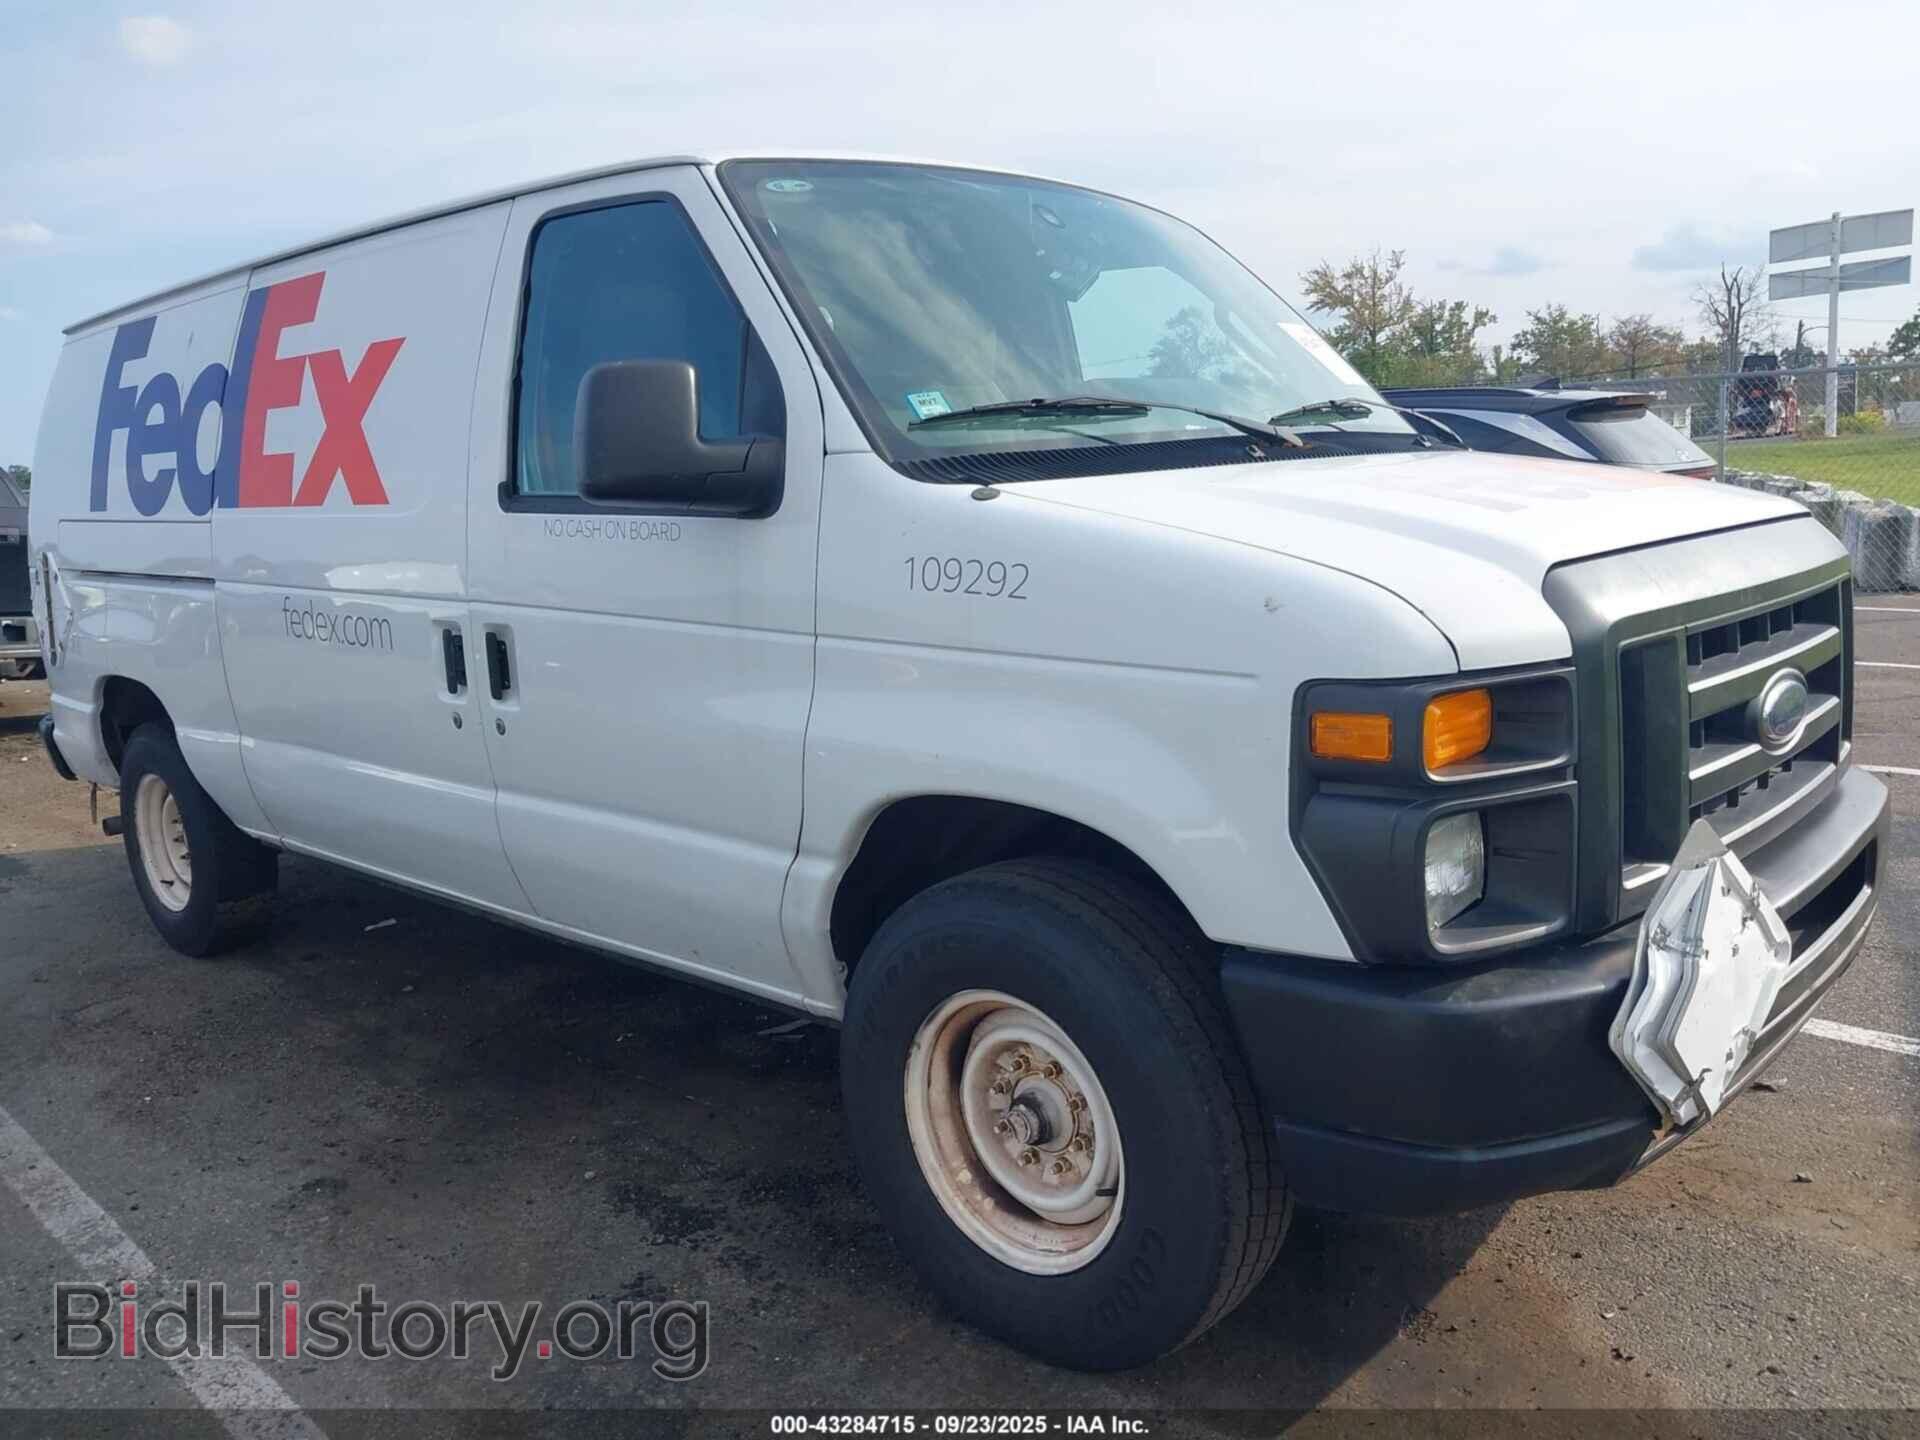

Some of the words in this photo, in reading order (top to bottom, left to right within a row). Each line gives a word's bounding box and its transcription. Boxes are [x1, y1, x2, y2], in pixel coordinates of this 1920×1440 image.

[90, 271, 406, 517] FedEx
[543, 518, 563, 537] NO
[566, 519, 601, 539] CASH
[605, 520, 626, 540] ON
[629, 521, 681, 542] BOARD
[904, 556, 1029, 600] 109292
[282, 596, 393, 650] fedex.com
